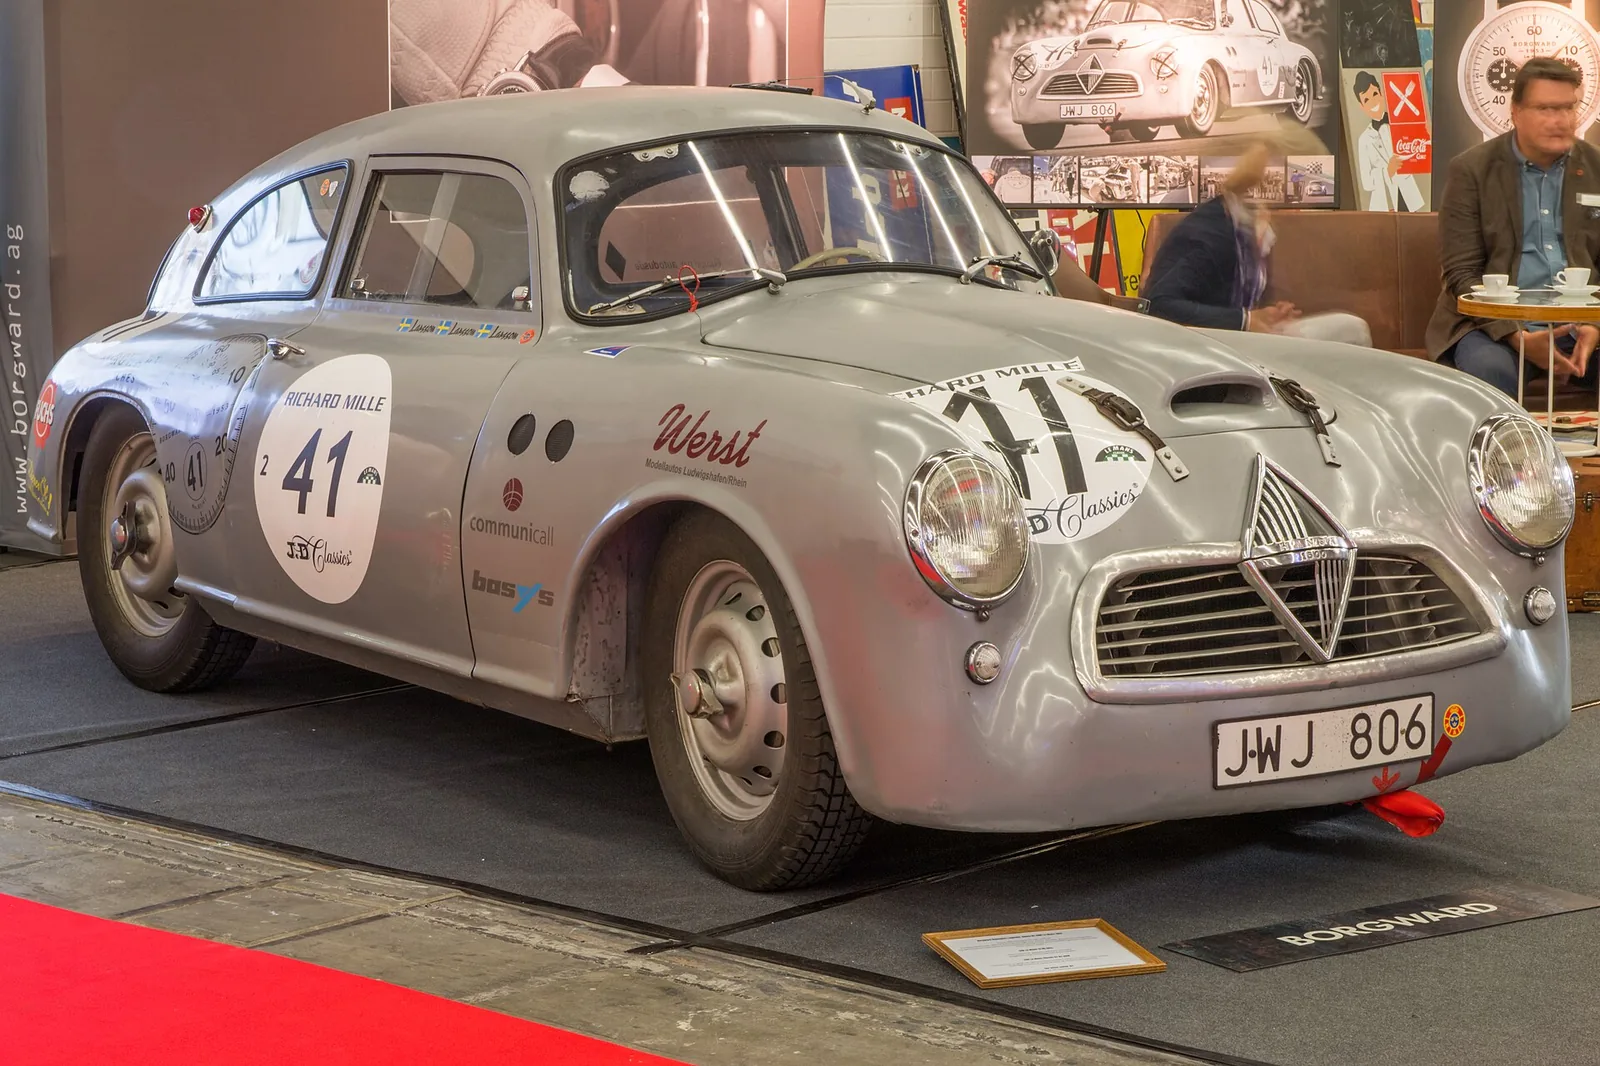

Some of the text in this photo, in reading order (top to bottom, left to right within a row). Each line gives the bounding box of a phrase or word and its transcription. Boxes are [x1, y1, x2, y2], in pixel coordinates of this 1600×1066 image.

[1526, 25, 1543, 36] 60
[1492, 46, 1506, 56] 50
[1564, 45, 1578, 55] 10
[1262, 55, 1273, 75] 41
[1091, 104, 1114, 116] 806
[1492, 95, 1506, 105] 40
[5, 223, 28, 514] www.borgward.ag
[227, 365, 246, 386] 10
[994, 360, 1082, 379] MILLE
[284, 391, 387, 412] RICHARD MILLE
[652, 403, 768, 468] Werst
[164, 461, 176, 484] 40
[187, 450, 204, 492] 41
[259, 454, 269, 476] 2
[281, 427, 354, 518] 41
[644, 457, 682, 475] Modellautos
[1054, 488, 1141, 539] Classics
[469, 515, 554, 547] communicall
[1224, 719, 1314, 777] JWJ
[1349, 703, 1427, 761] 806
[1276, 901, 1499, 947] BORGWARD
